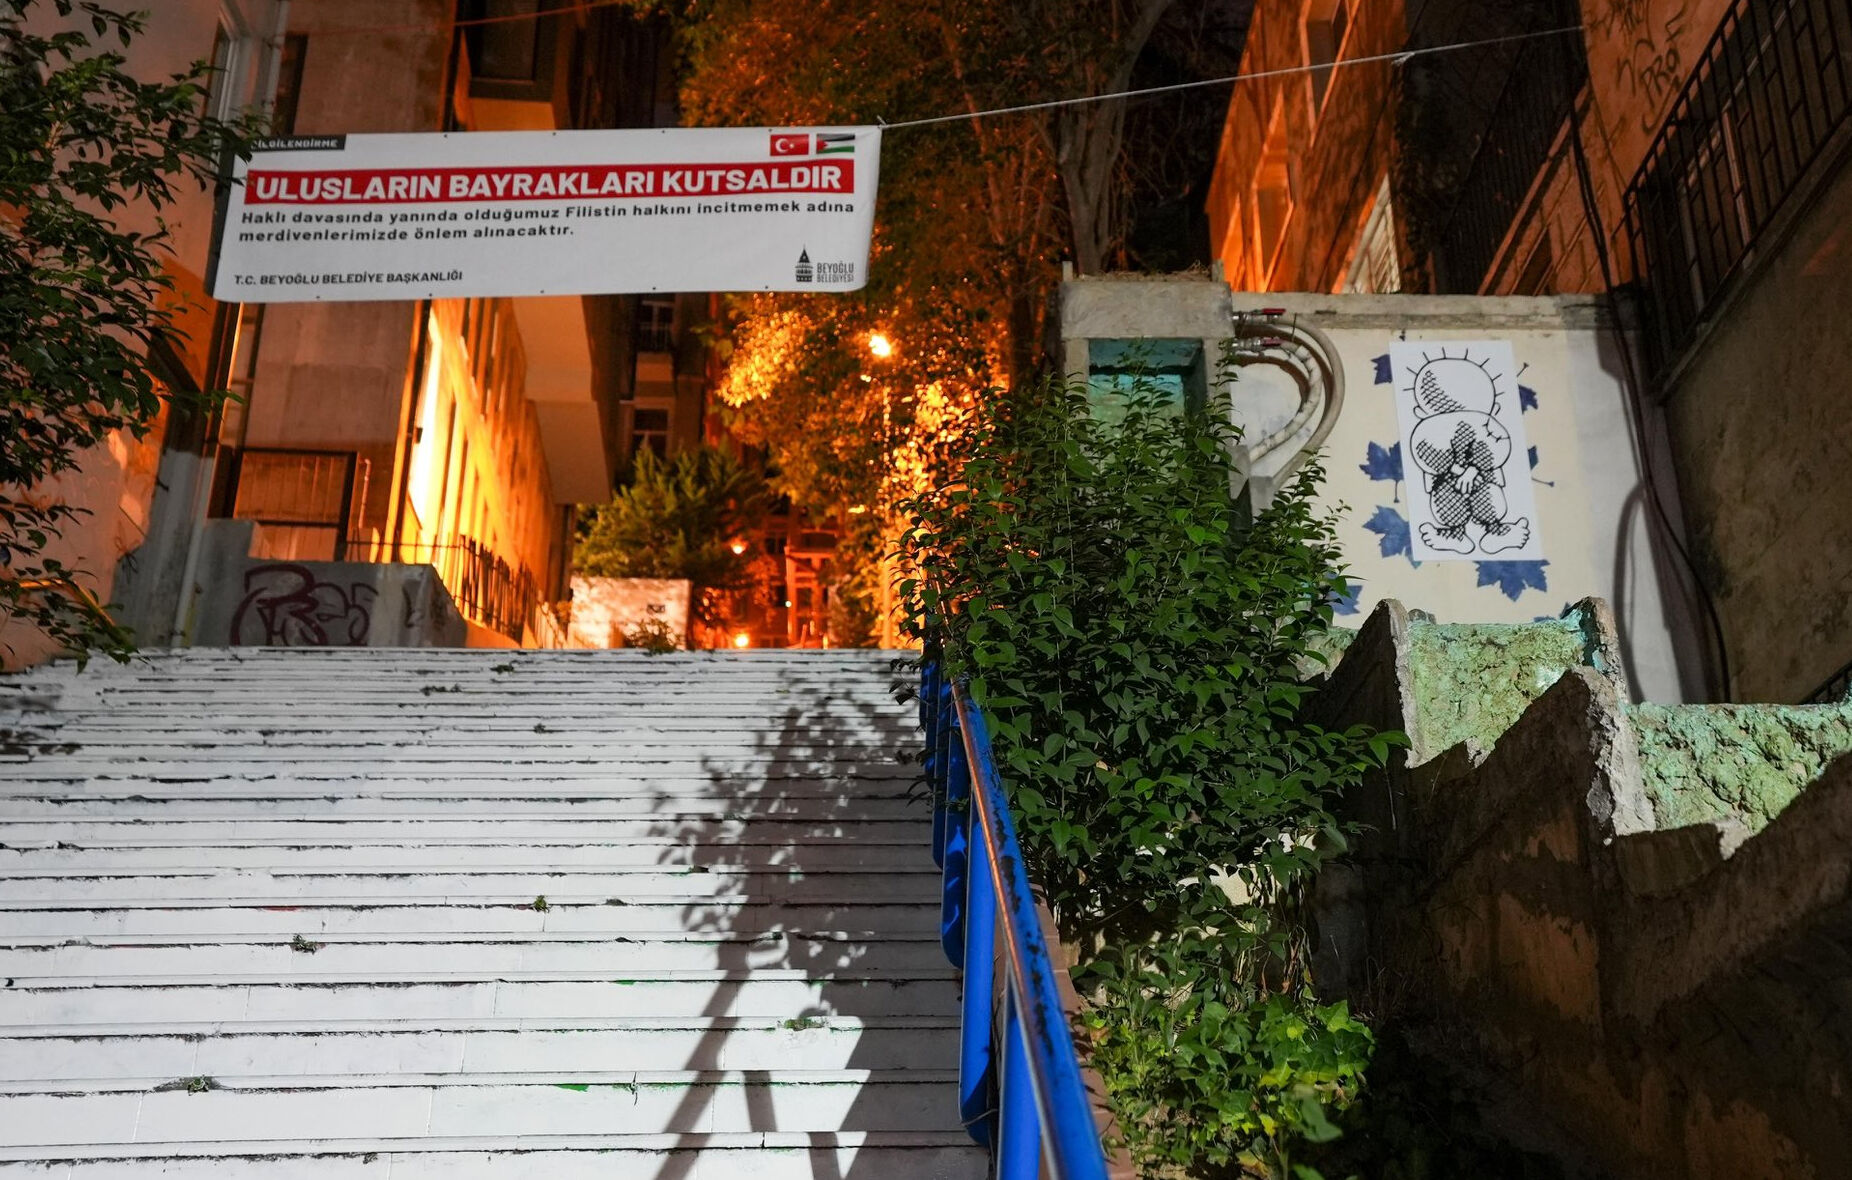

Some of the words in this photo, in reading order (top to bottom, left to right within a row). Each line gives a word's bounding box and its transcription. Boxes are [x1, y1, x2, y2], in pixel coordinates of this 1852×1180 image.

[256, 176, 441, 200] ULUSLARIN
[449, 171, 653, 197] BAYRAKLARI
[662, 166, 841, 192] KUTSALDIR
[241, 211, 286, 224] Haklı
[292, 211, 383, 223] davasında
[389, 210, 458, 226] yanında
[464, 206, 558, 222] olduğumuz
[565, 206, 627, 218] Filistin
[632, 205, 691, 216] halkını
[697, 202, 800, 214] incitmemek
[806, 202, 854, 213] adına
[239, 229, 408, 242] merdivenlerimizde
[414, 228, 467, 240] önlem
[473, 225, 574, 238] alınacaktır.
[816, 260, 854, 274] BEYOĞLU
[235, 275, 257, 285] T.C.
[260, 272, 319, 285] BEYOĞLU
[322, 271, 384, 284] BELEDİYE
[386, 270, 463, 284] BAŞKANLIĞI
